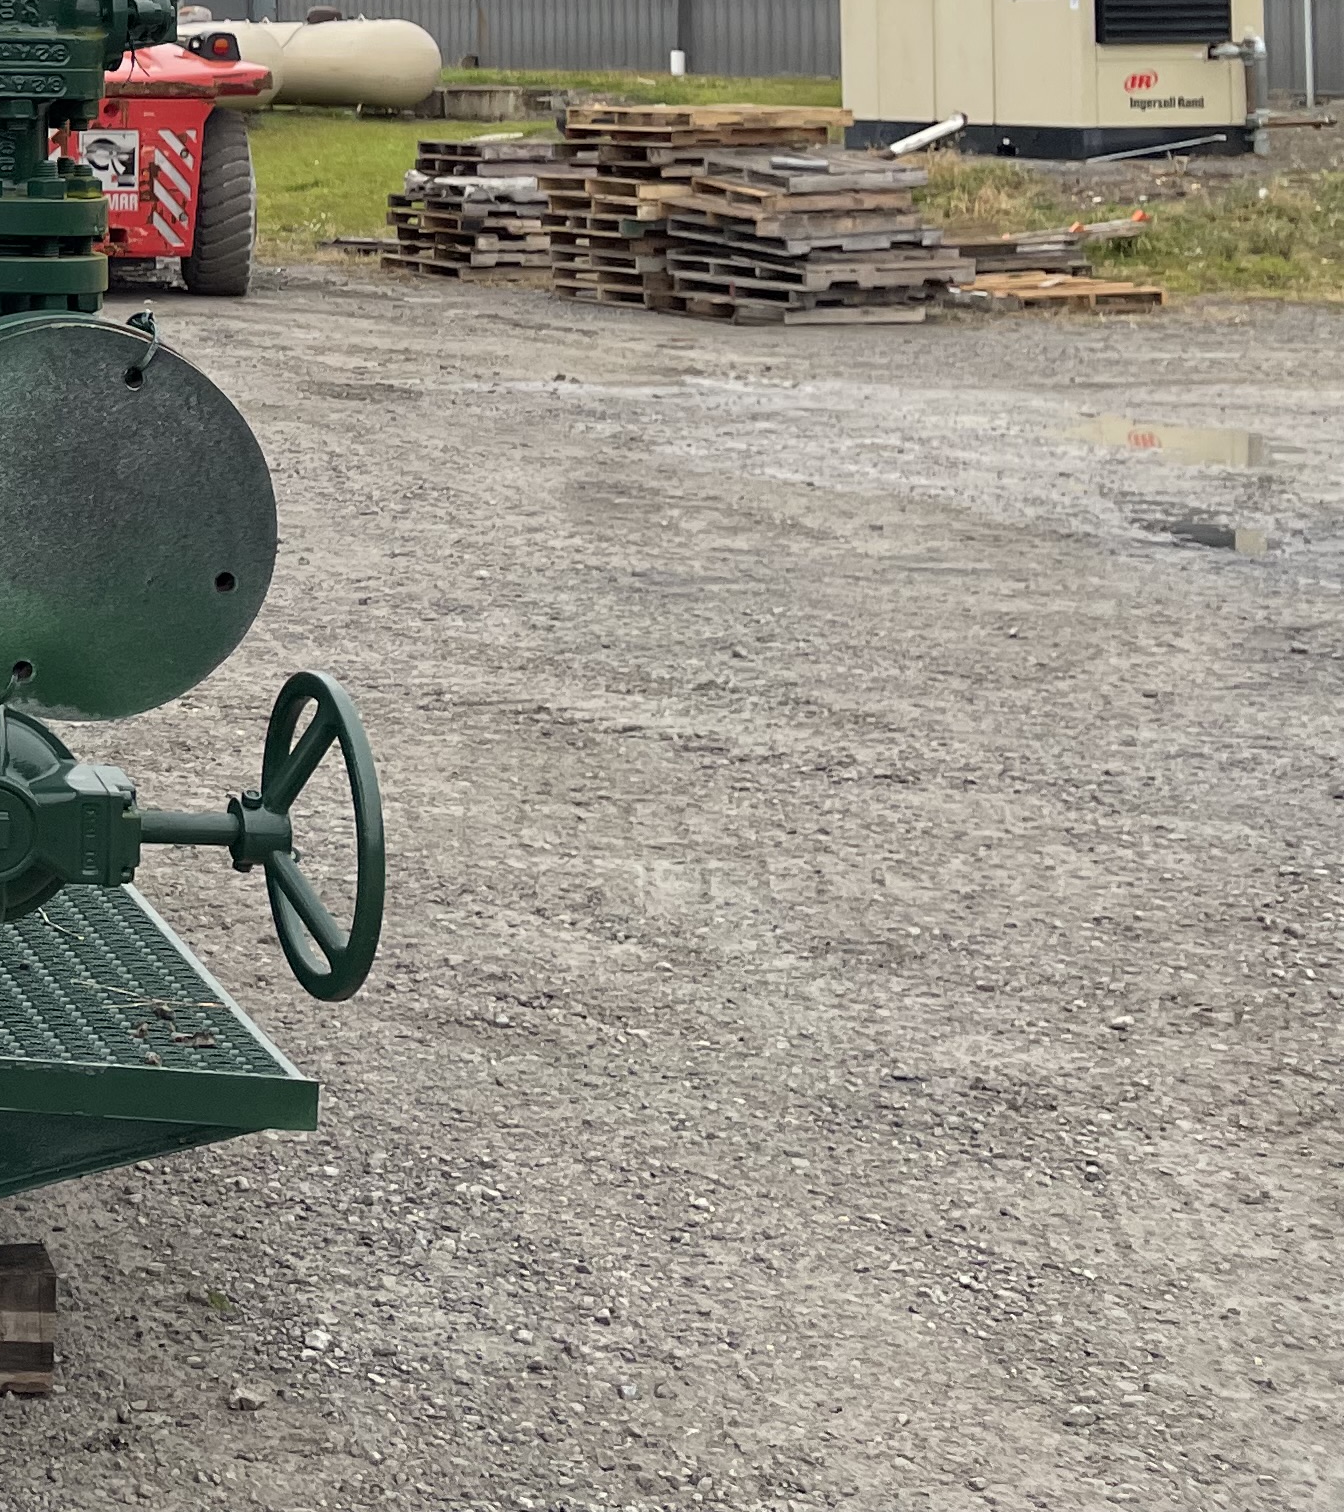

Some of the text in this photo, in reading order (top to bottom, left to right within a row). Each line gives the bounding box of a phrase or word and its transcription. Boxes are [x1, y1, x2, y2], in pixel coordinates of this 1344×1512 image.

[1130, 95, 1205, 112] Ingersoll Rand
[106, 193, 138, 211] MAR
